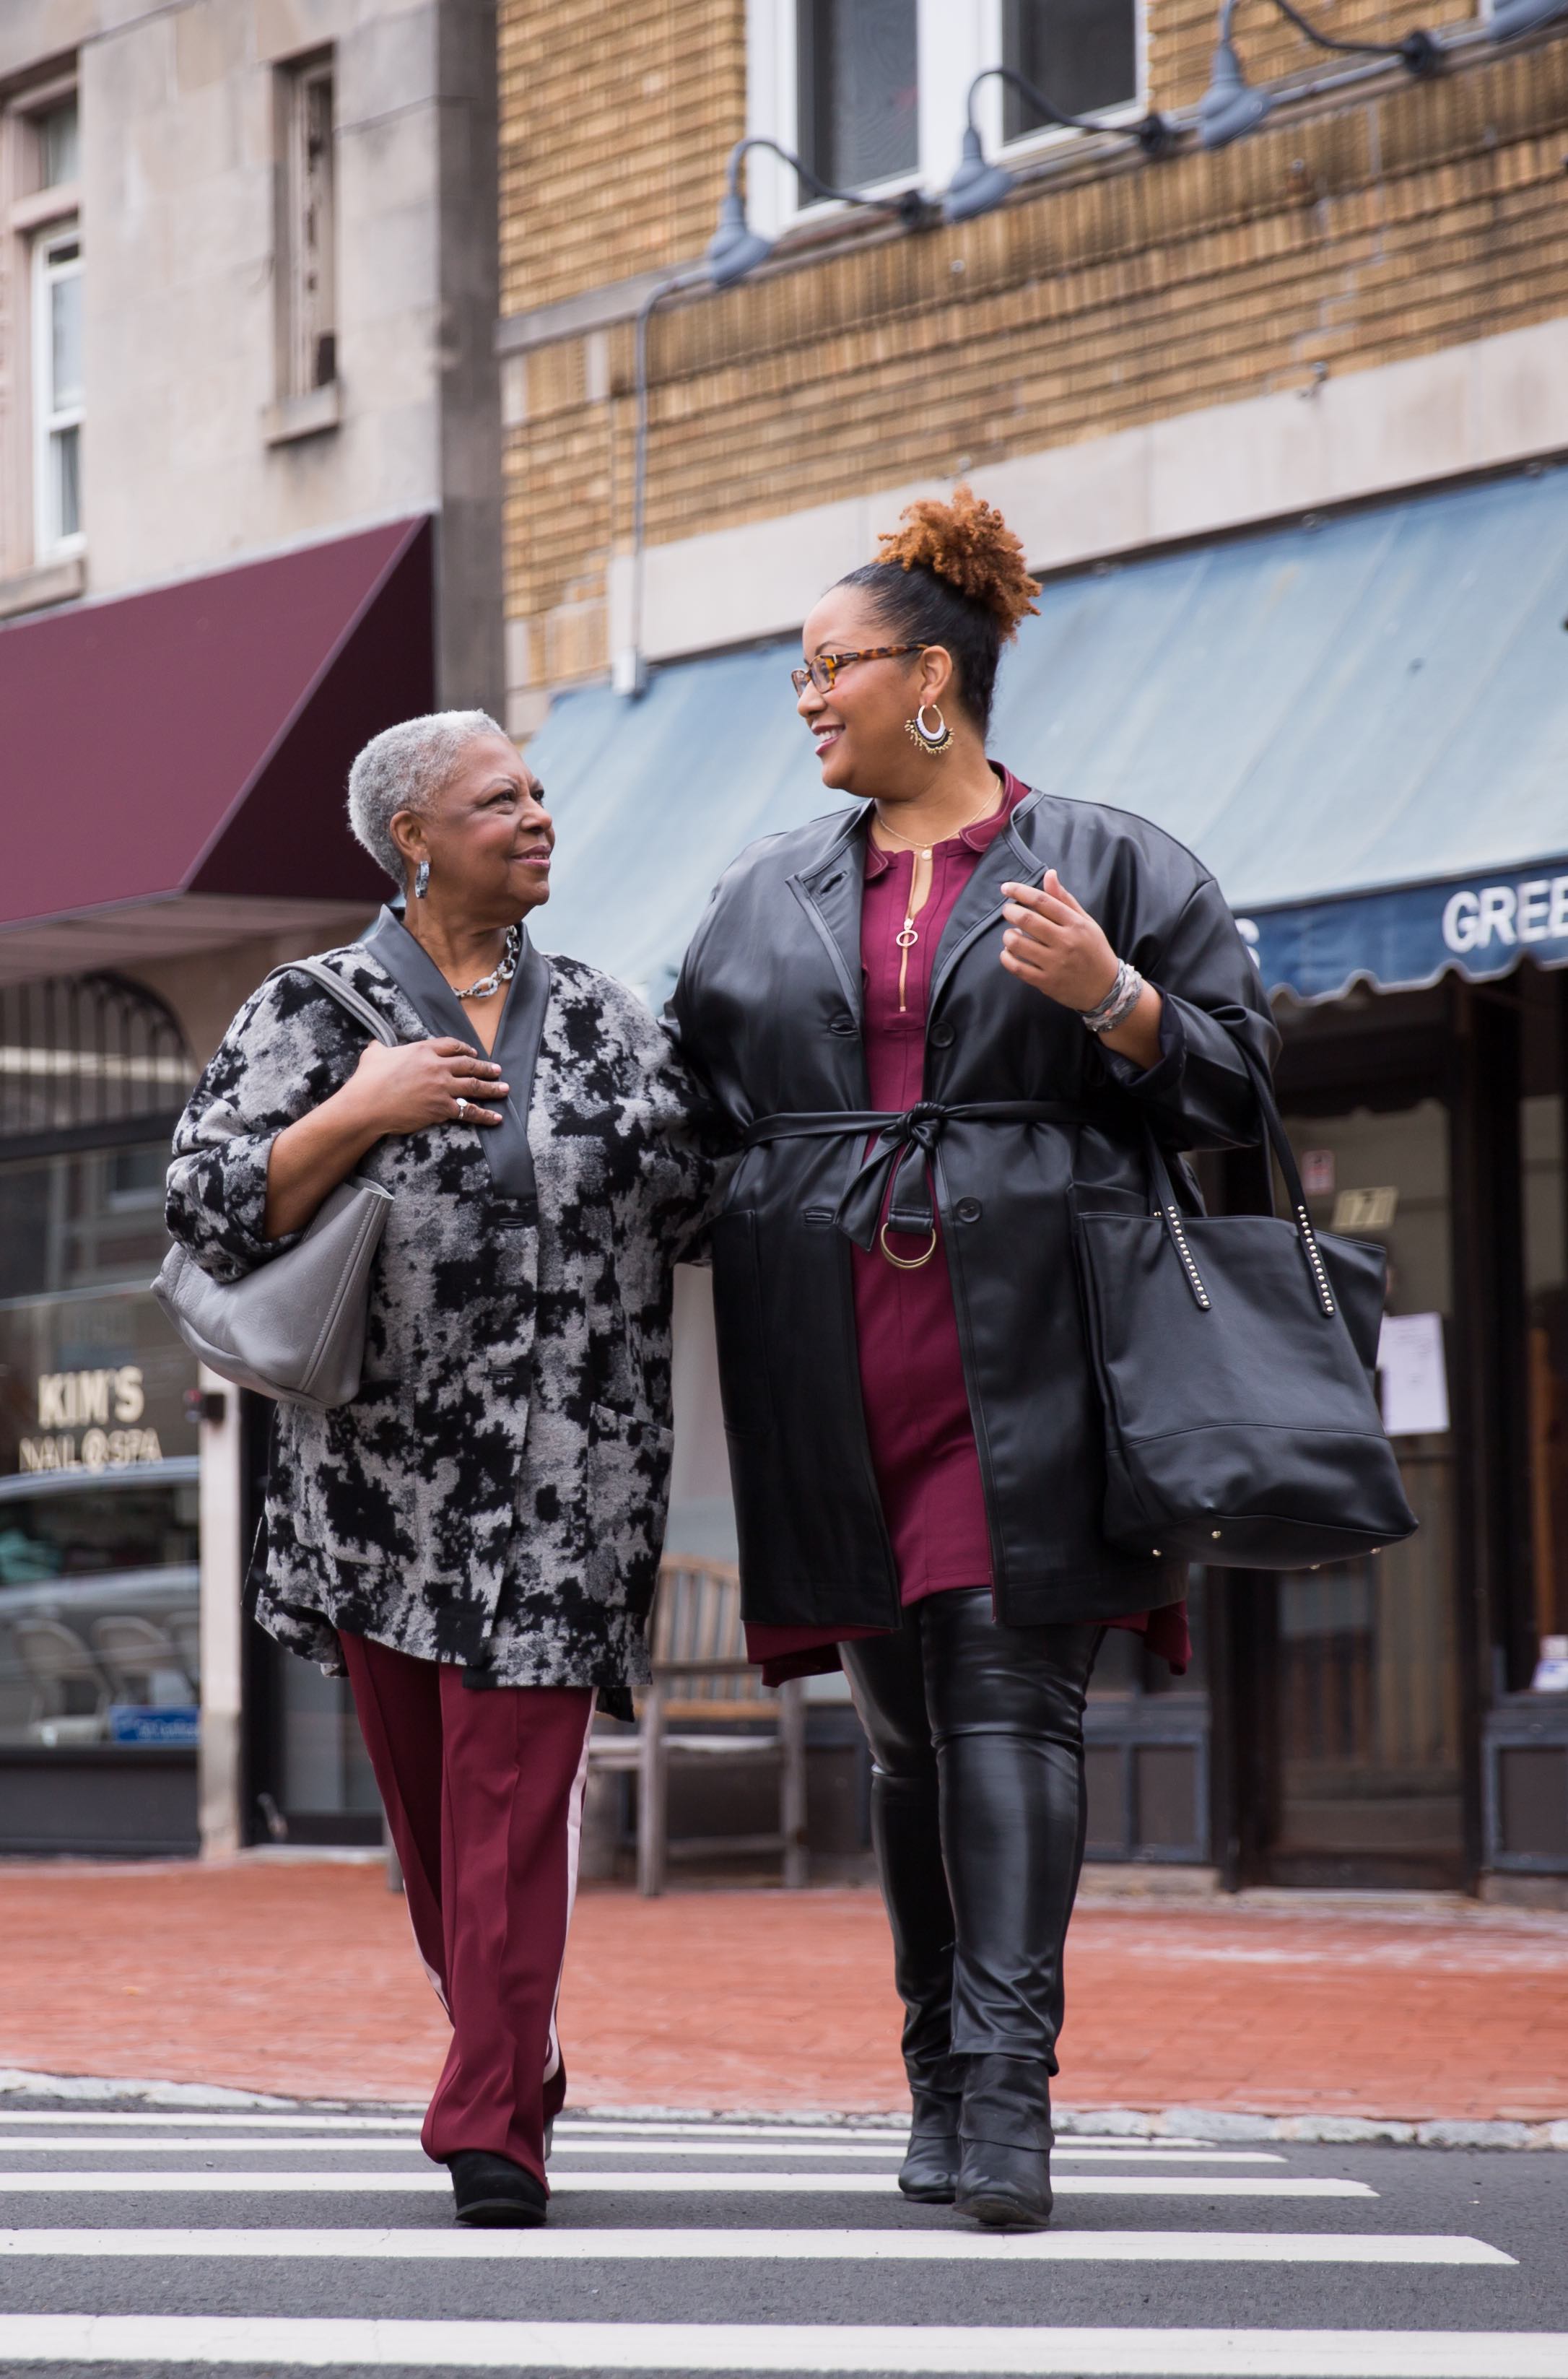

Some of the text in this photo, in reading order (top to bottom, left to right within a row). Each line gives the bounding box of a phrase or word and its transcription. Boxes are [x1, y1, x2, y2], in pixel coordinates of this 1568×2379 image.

[38, 1365, 144, 1430] KIM'S
[19, 1434, 81, 1474] NAIL
[108, 1427, 163, 1470] SPA
